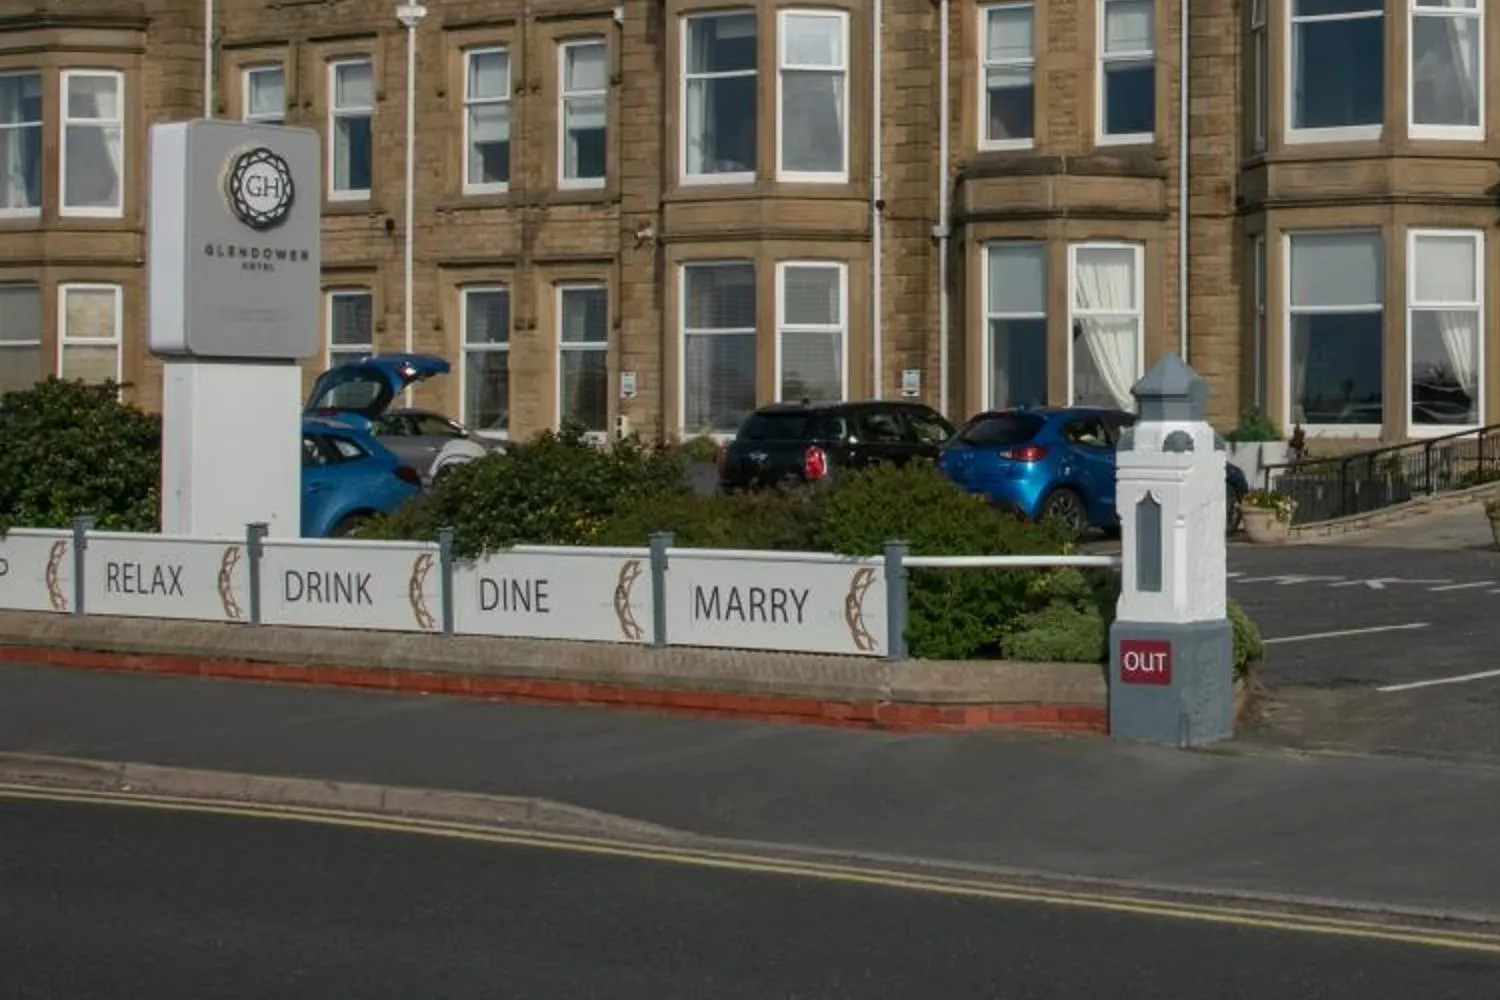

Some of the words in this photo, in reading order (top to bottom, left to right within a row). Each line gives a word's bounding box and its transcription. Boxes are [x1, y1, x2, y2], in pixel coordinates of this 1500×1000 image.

[246, 175, 280, 199] GH
[107, 562, 184, 597] RELAX
[285, 570, 373, 605] DRINK
[479, 578, 550, 613] DINE
[695, 585, 809, 624] MARRY
[1124, 651, 1167, 672] OUT
